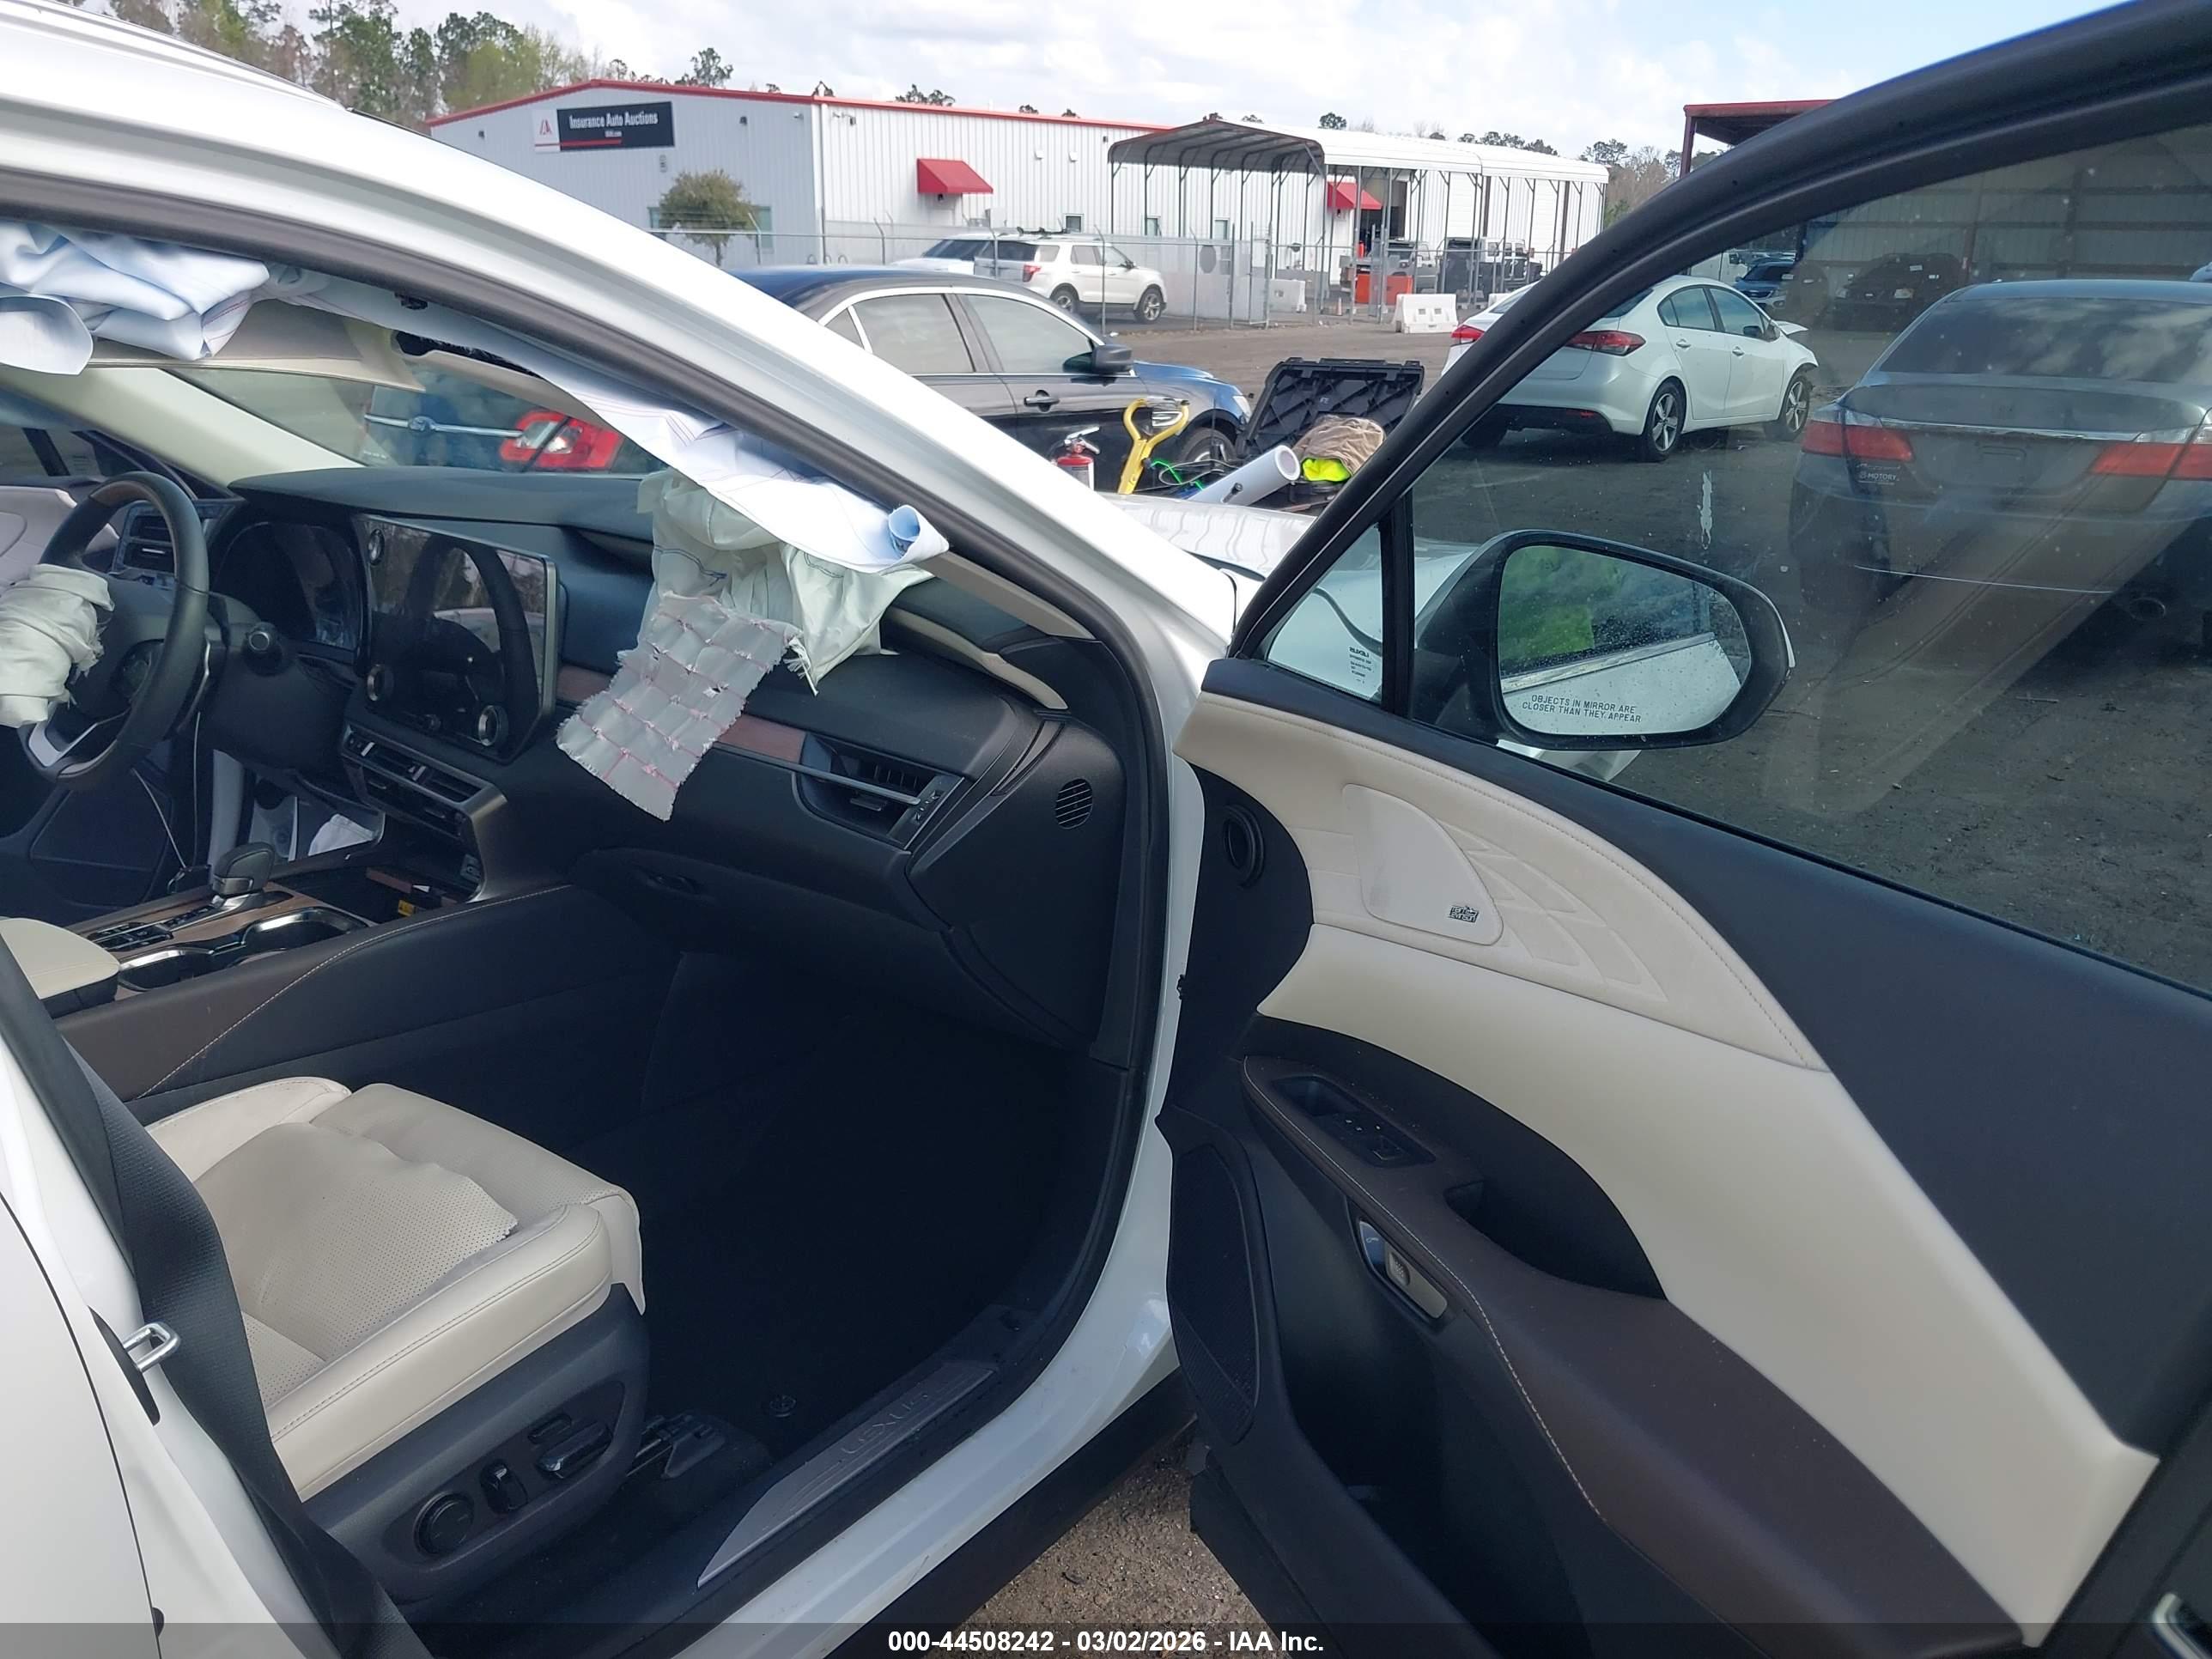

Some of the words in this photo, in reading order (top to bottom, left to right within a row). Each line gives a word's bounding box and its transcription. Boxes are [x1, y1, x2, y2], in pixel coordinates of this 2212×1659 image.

[568, 114, 605, 129] Insurance
[606, 112, 623, 127] Auto
[624, 110, 659, 126] Auctions
[1522, 702, 1555, 714] CLOSER
[1558, 706, 1580, 715] THAN
[1583, 708, 1606, 719] THEY
[1607, 712, 1642, 723] APPEAR
[1531, 695, 1570, 707] OBJECTS
[1572, 699, 1581, 708] IN
[1583, 701, 1616, 712] MIRROR
[1619, 705, 1636, 714] ARE
